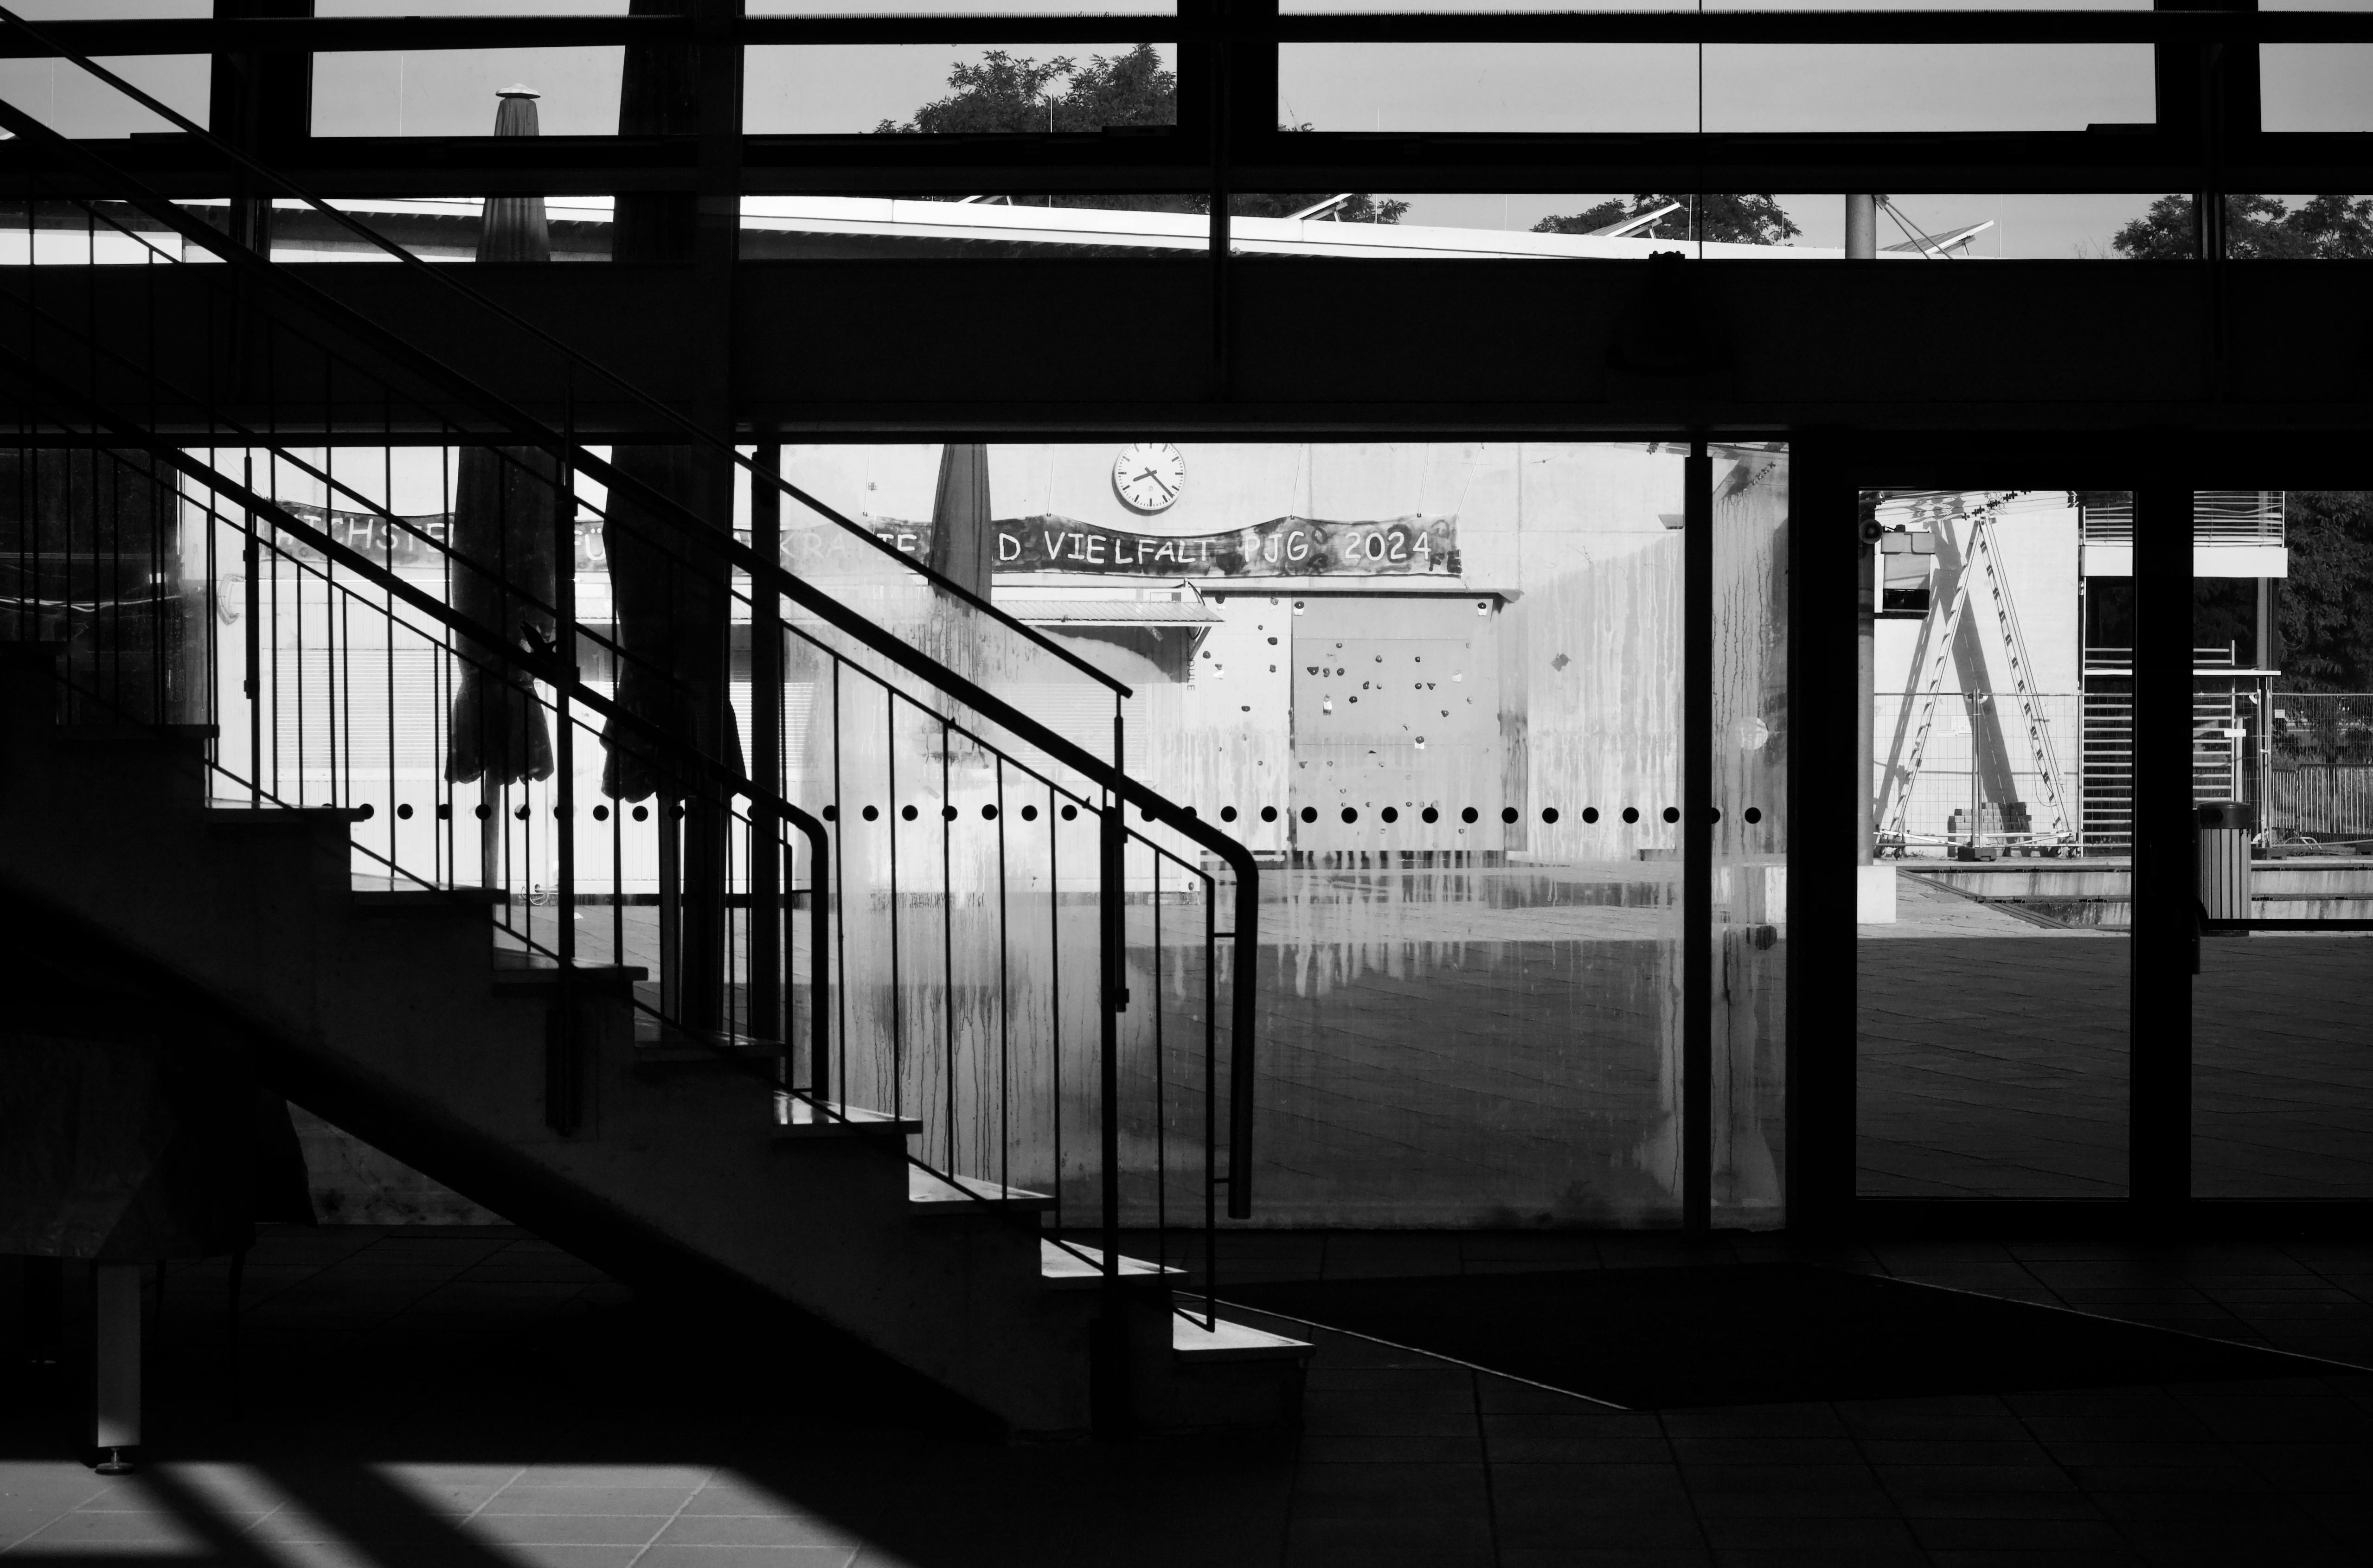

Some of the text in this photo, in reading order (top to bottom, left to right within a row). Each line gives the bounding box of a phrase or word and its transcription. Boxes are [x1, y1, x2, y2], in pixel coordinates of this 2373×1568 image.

[1044, 531, 1216, 564] VIELFALT
[1244, 531, 1308, 563] PJG
[1345, 531, 1432, 561] 2024
[1187, 658, 1195, 691] DULE
